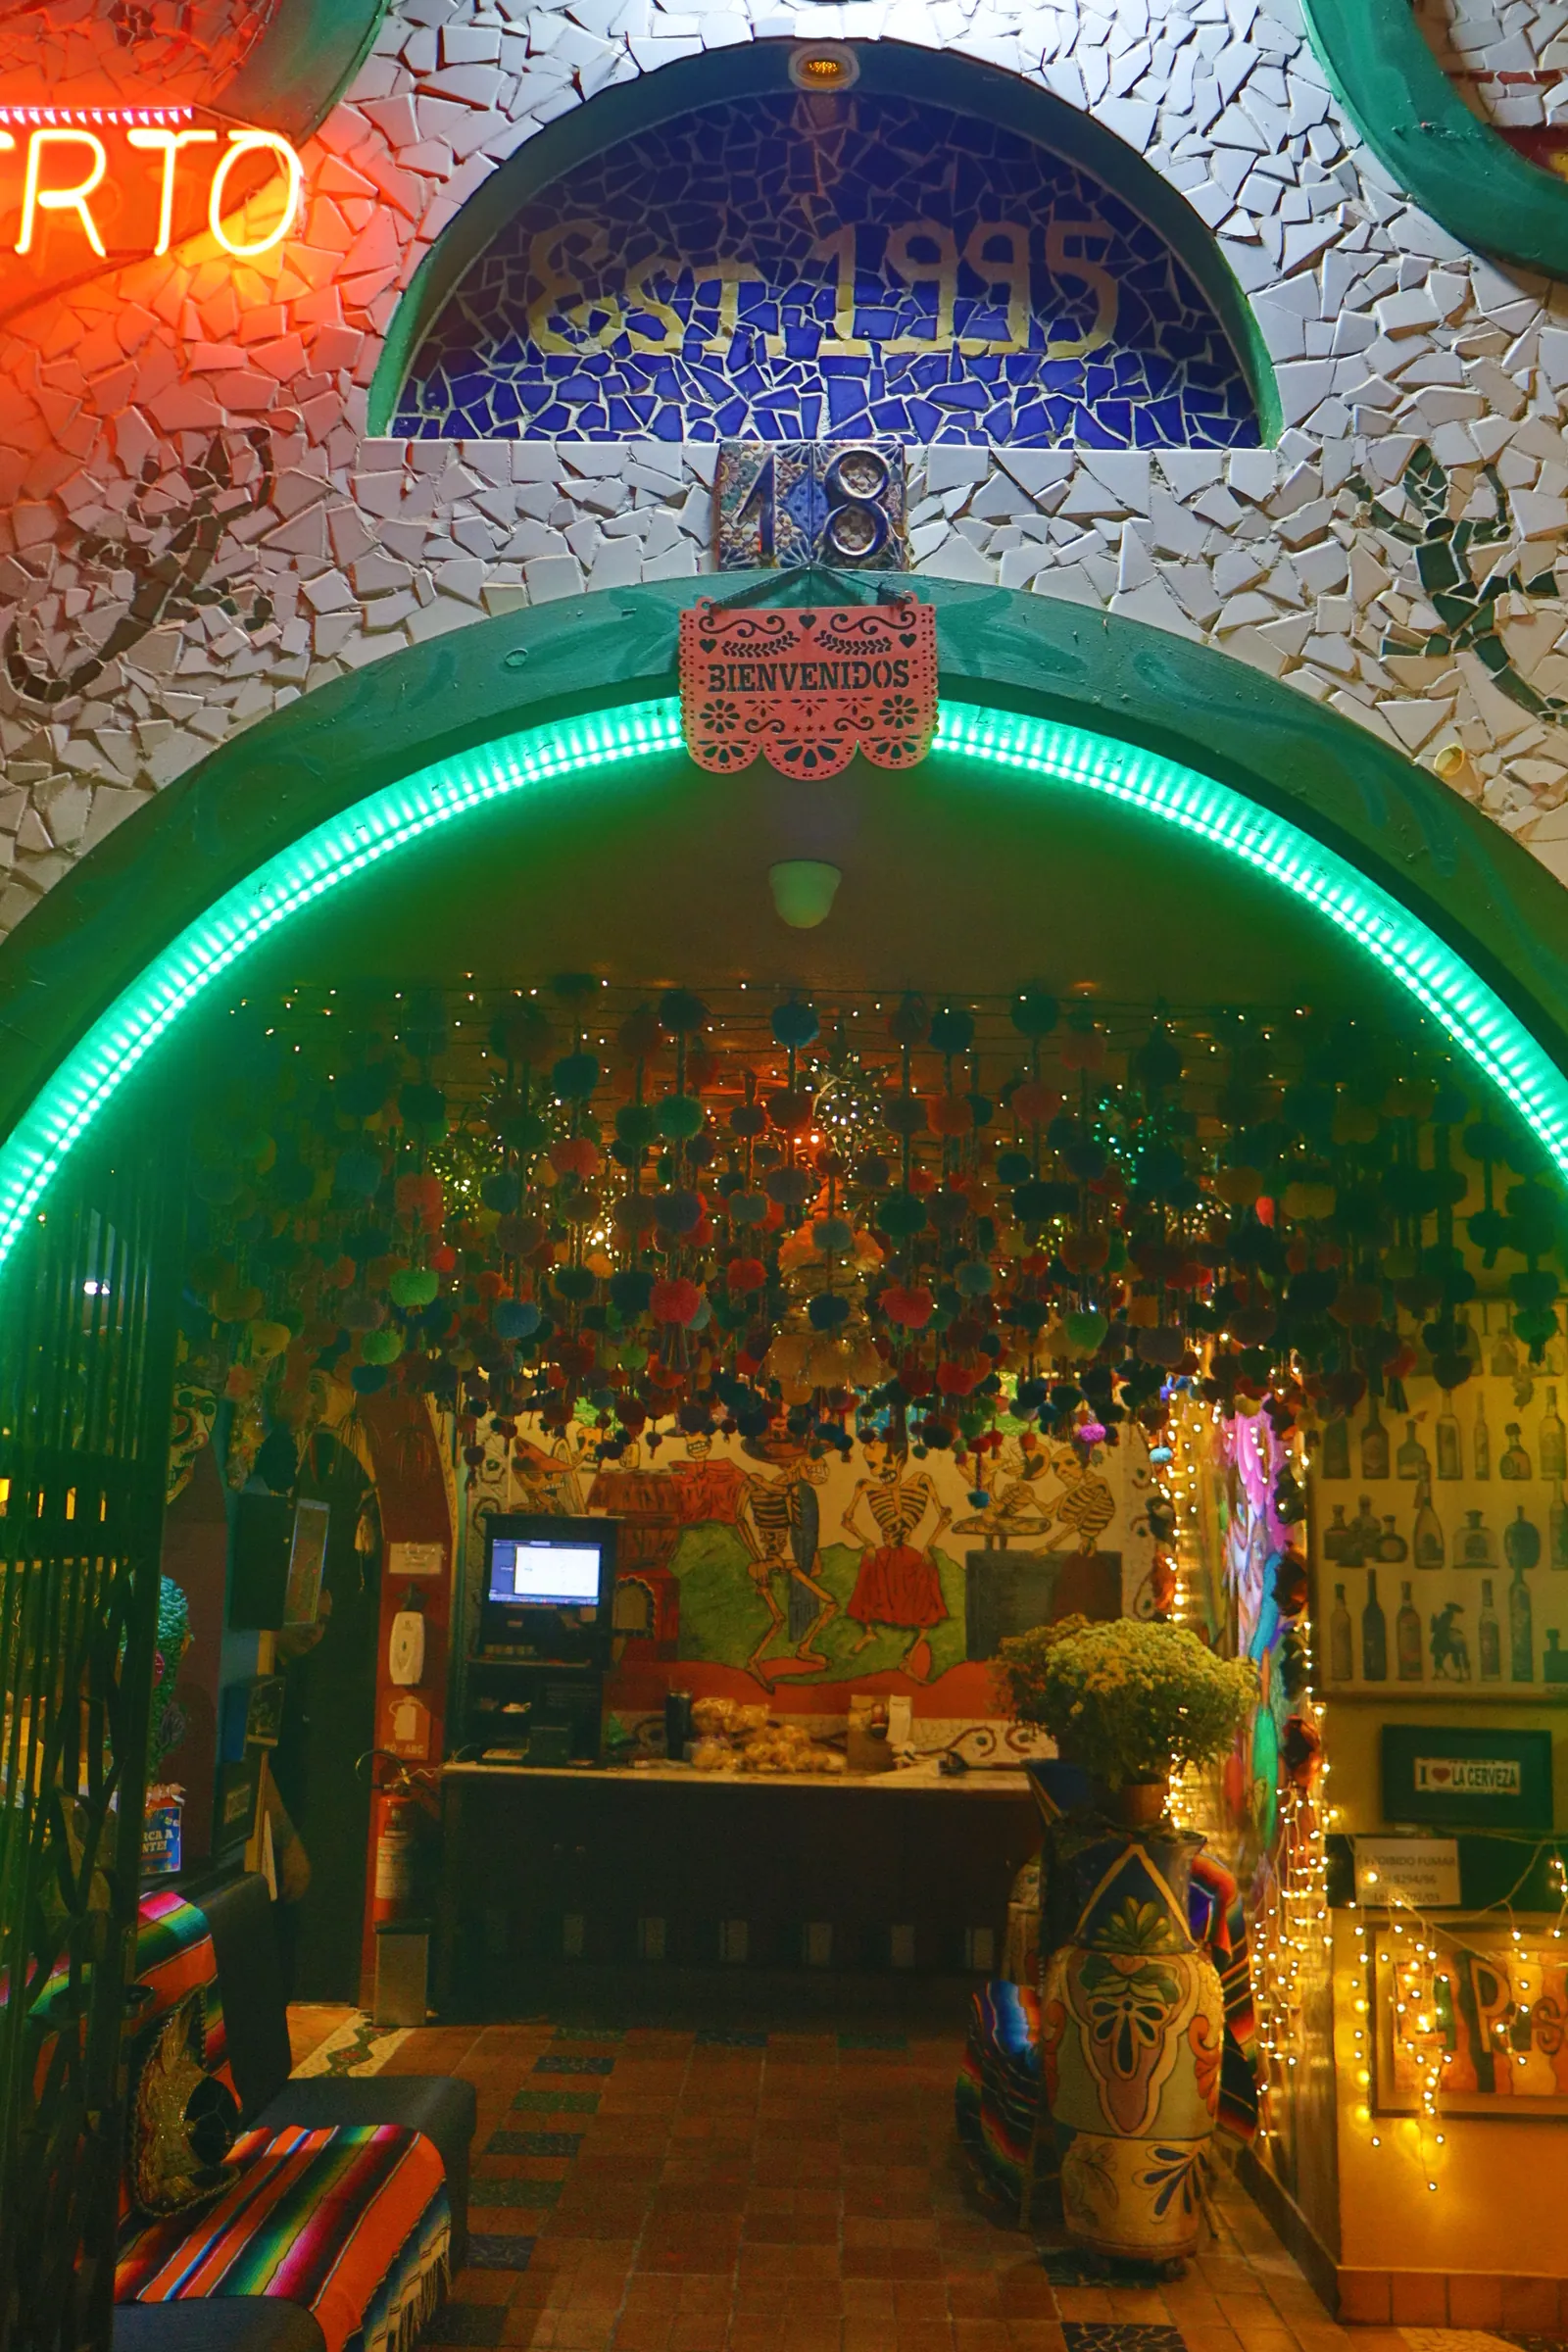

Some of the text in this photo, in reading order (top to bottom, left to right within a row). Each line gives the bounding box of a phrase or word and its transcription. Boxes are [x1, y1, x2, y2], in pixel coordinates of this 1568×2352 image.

[0, 128, 304, 258] RTO
[804, 218, 1119, 356] 1995
[737, 448, 890, 560] 18
[707, 659, 910, 693] BIENVENIDOS
[1419, 1766, 1516, 1788] I LA CERVEZA
